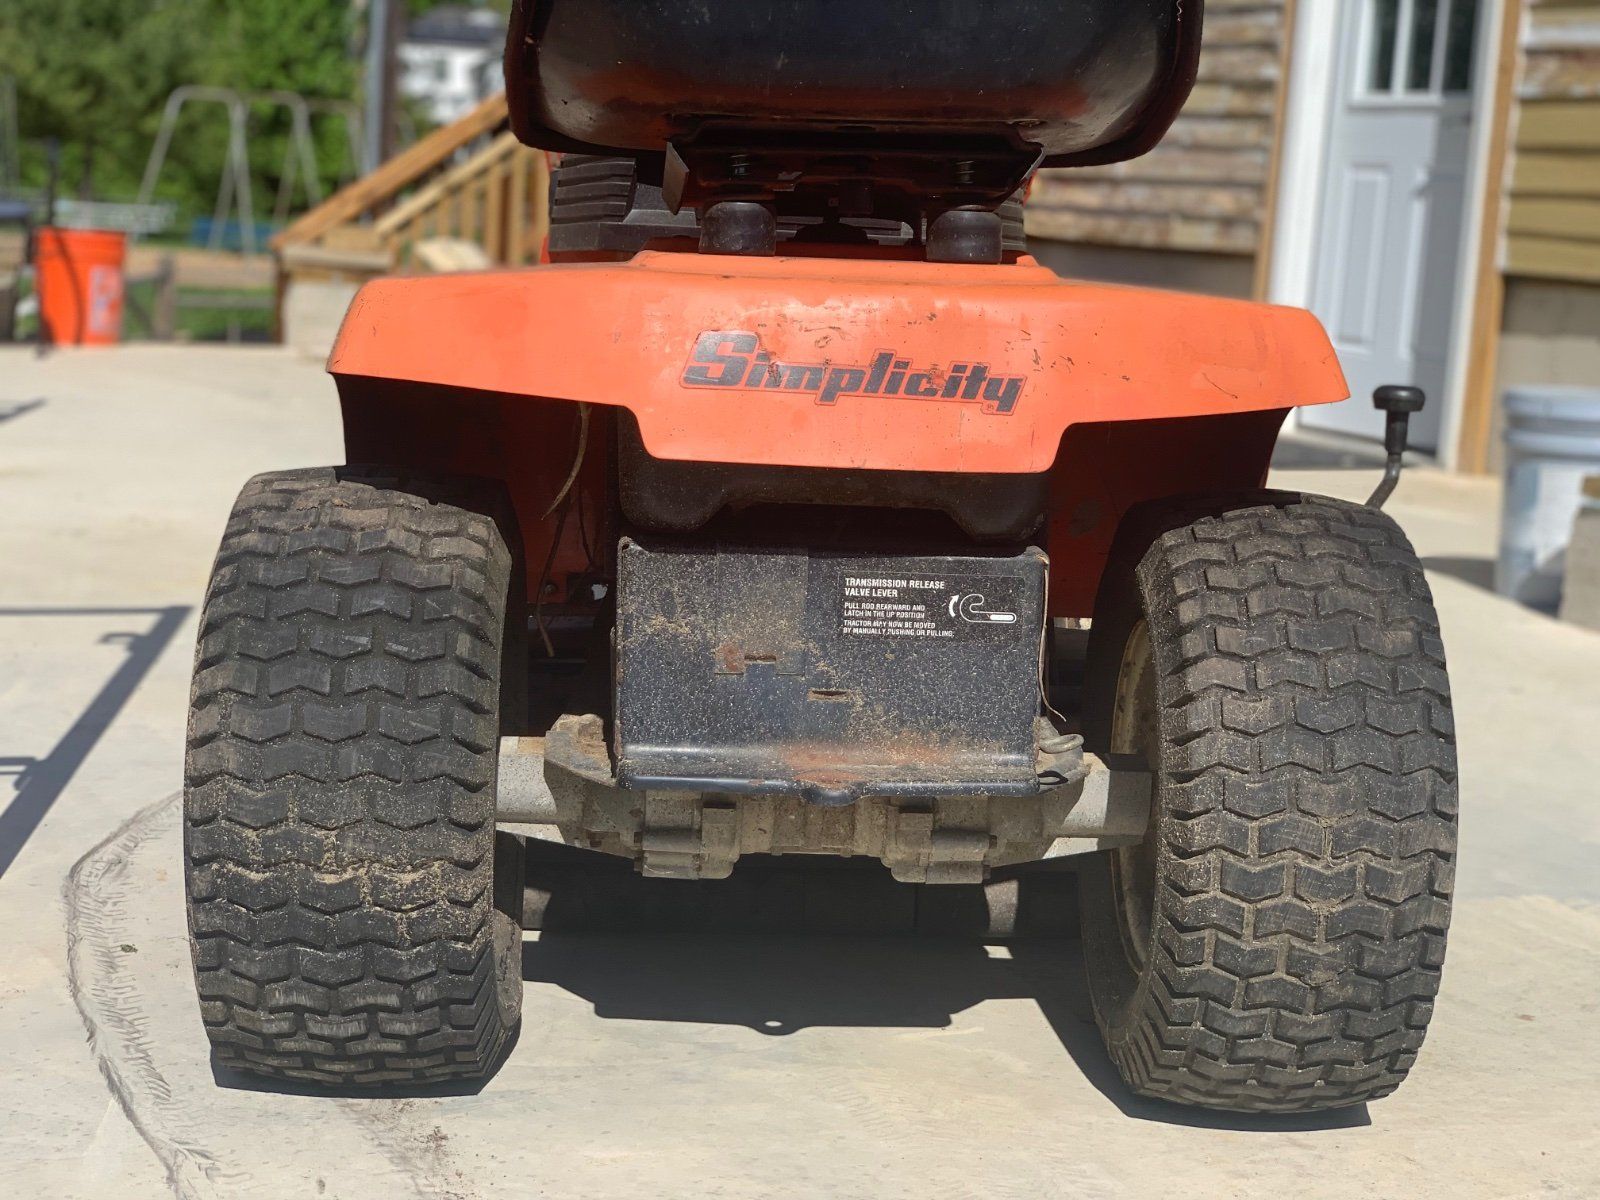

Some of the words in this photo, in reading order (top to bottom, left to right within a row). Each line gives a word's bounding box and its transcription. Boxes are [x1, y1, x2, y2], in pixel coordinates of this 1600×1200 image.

[682, 333, 1024, 413] Simplicity
[845, 578, 907, 588] TRANSMISSION
[909, 580, 945, 589] RELEASE
[844, 587, 870, 597] VALVE
[872, 588, 898, 597] LEVER
[876, 603, 911, 611] REARWARD
[896, 611, 925, 619] POSITION
[913, 621, 936, 629] MOVED
[853, 627, 886, 635] MANUALLY
